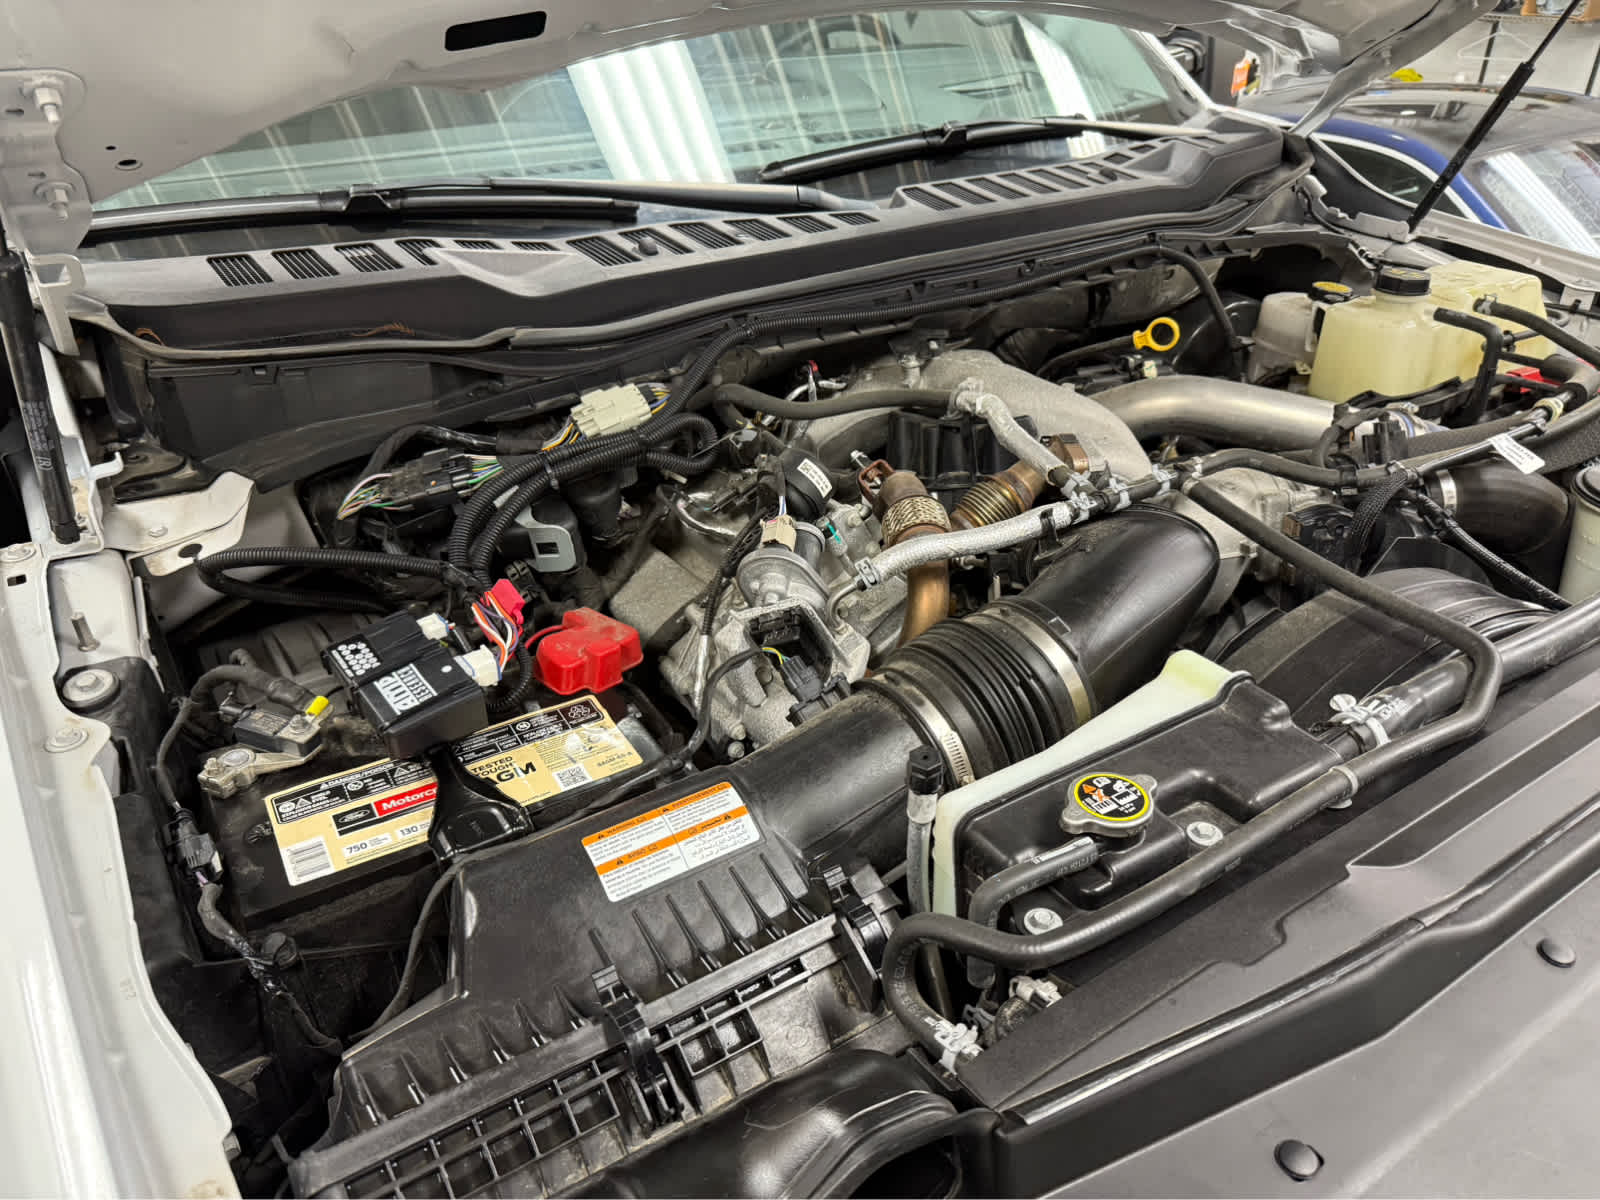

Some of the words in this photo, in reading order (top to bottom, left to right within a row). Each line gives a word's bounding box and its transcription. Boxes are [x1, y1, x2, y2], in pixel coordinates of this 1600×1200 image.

[471, 756, 513, 773] TESTED
[475, 762, 513, 777] OUGH
[399, 826, 418, 837] 130
[346, 842, 367, 854] 750
